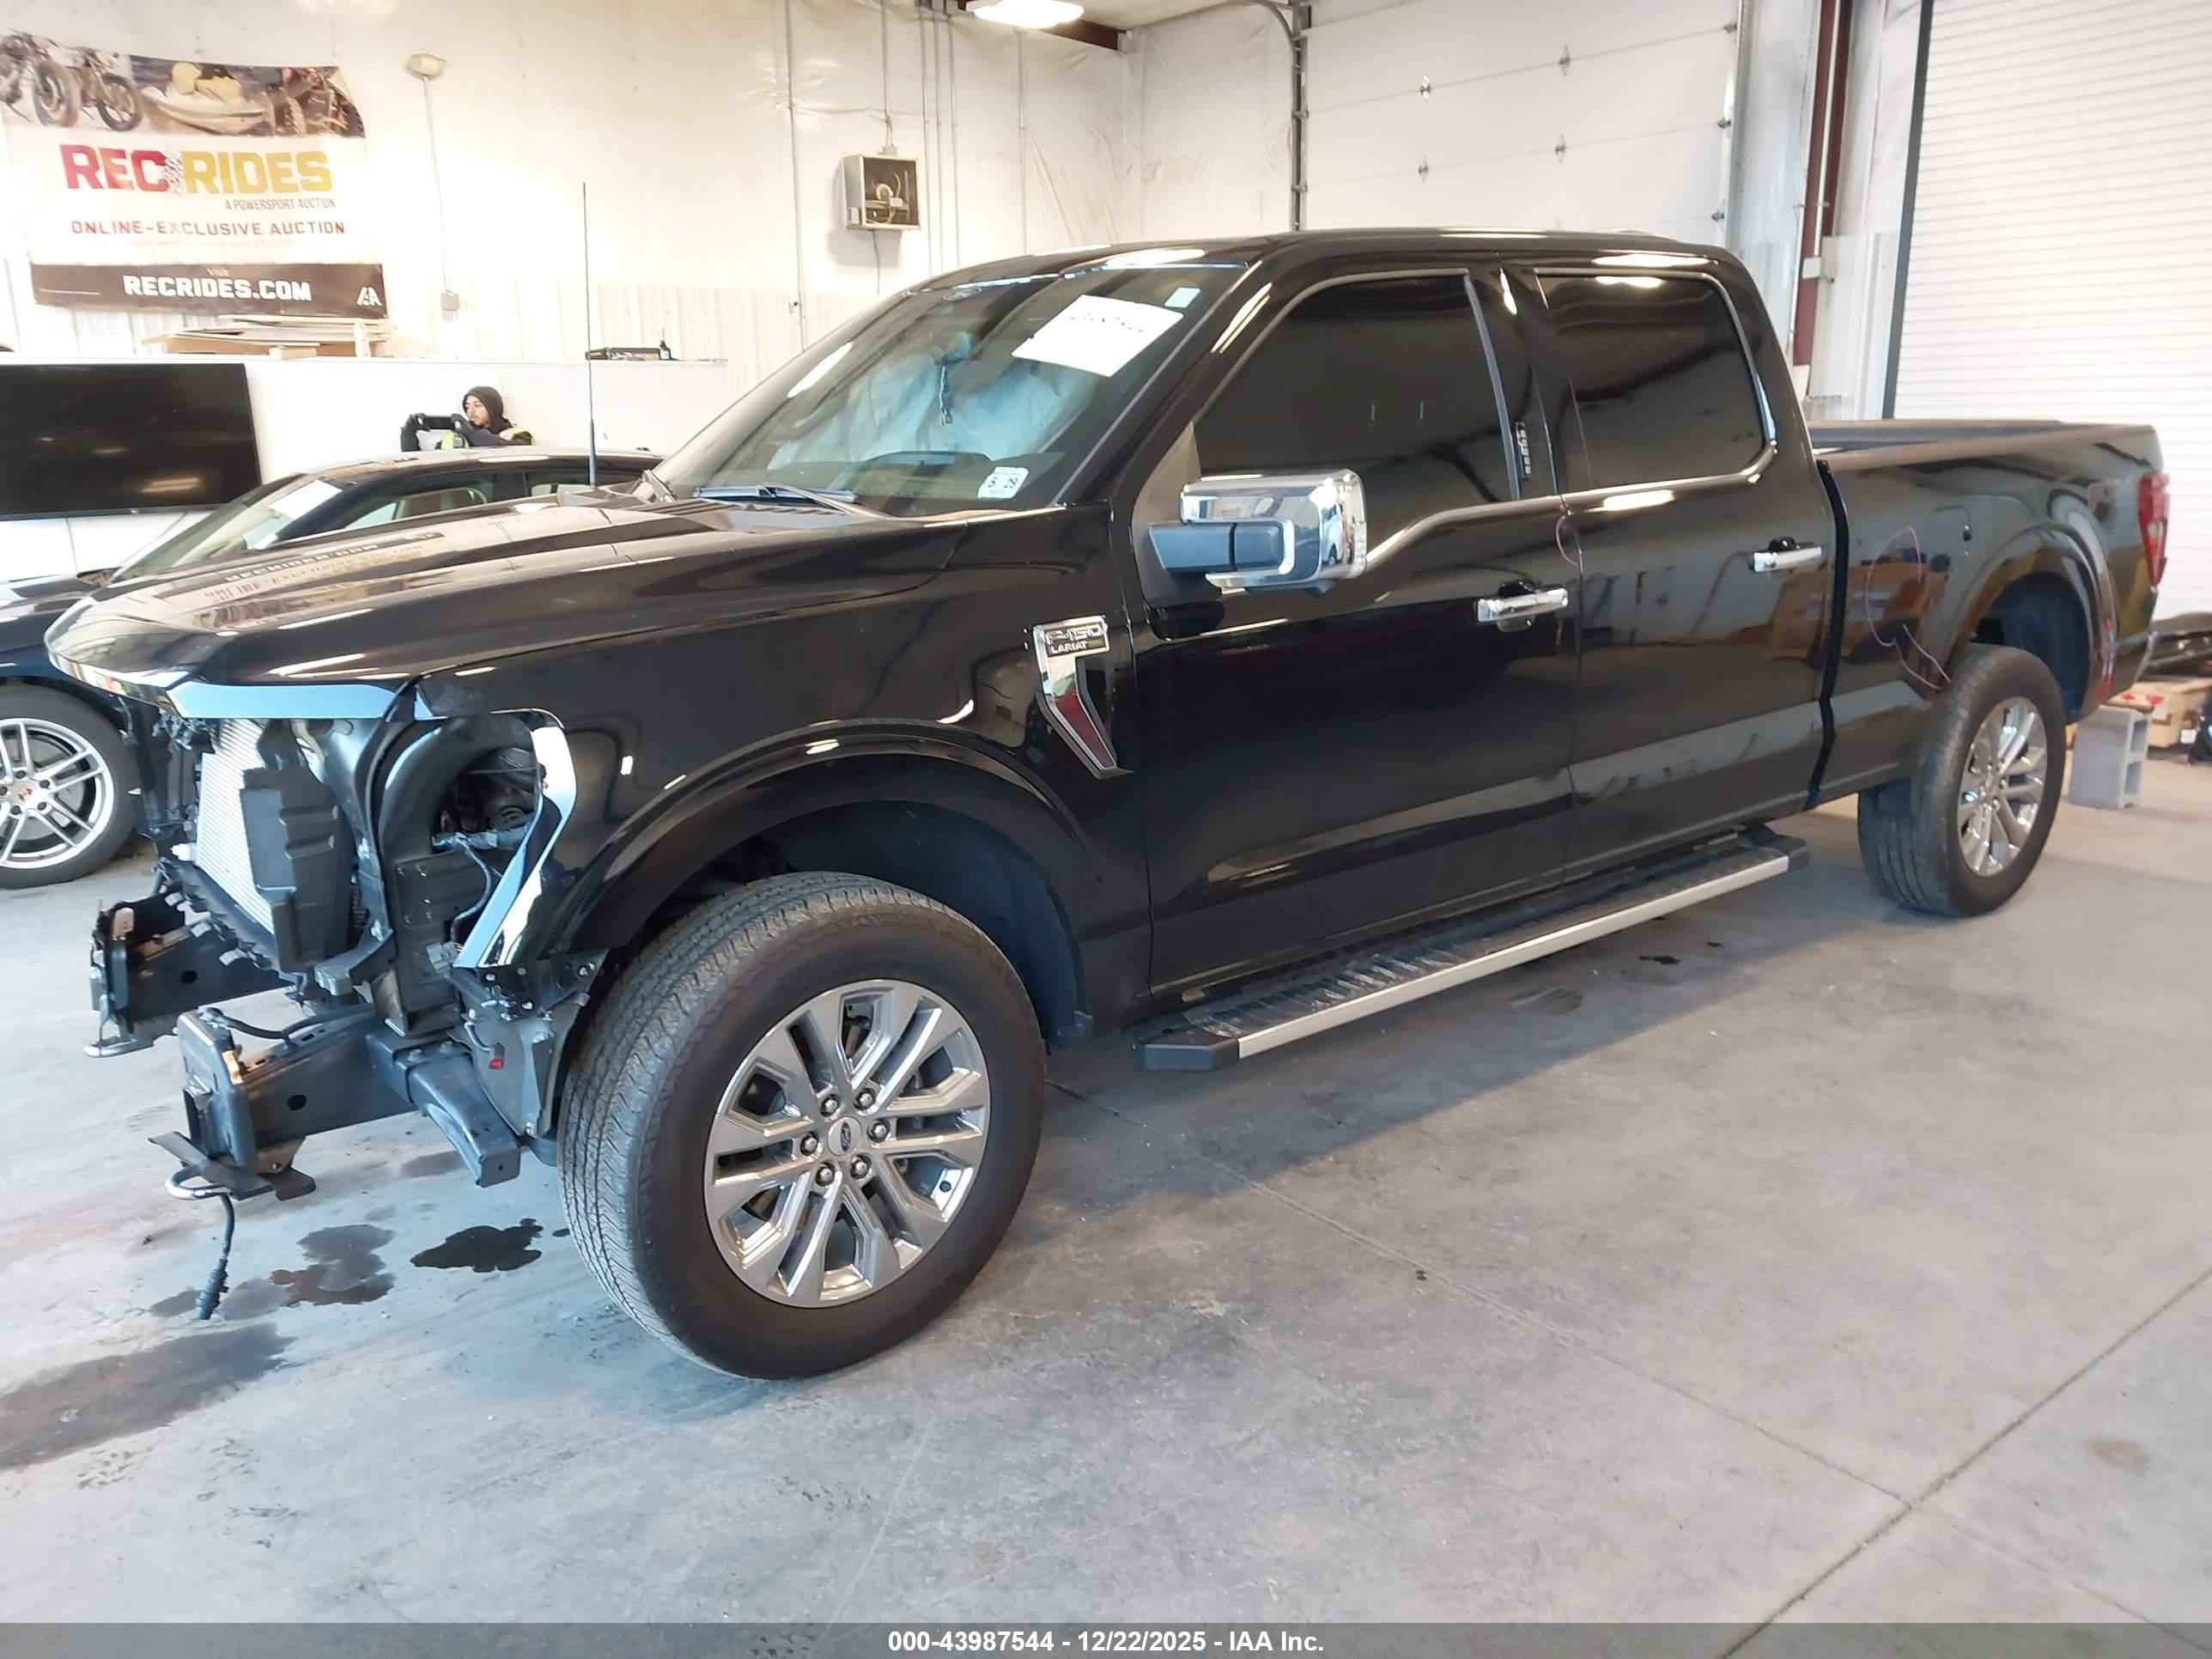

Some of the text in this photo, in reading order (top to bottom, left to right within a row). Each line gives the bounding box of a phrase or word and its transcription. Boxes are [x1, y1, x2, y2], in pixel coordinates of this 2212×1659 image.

[59, 144, 332, 194] REC RIDES
[233, 198, 295, 210] POWERSPORT
[297, 198, 336, 209] AUCTION
[71, 220, 345, 236] ONLINE-EXCLUSIVE AUCTION
[123, 275, 313, 301] RECRIDES.COM
[1050, 641, 1088, 653] LARIAT
